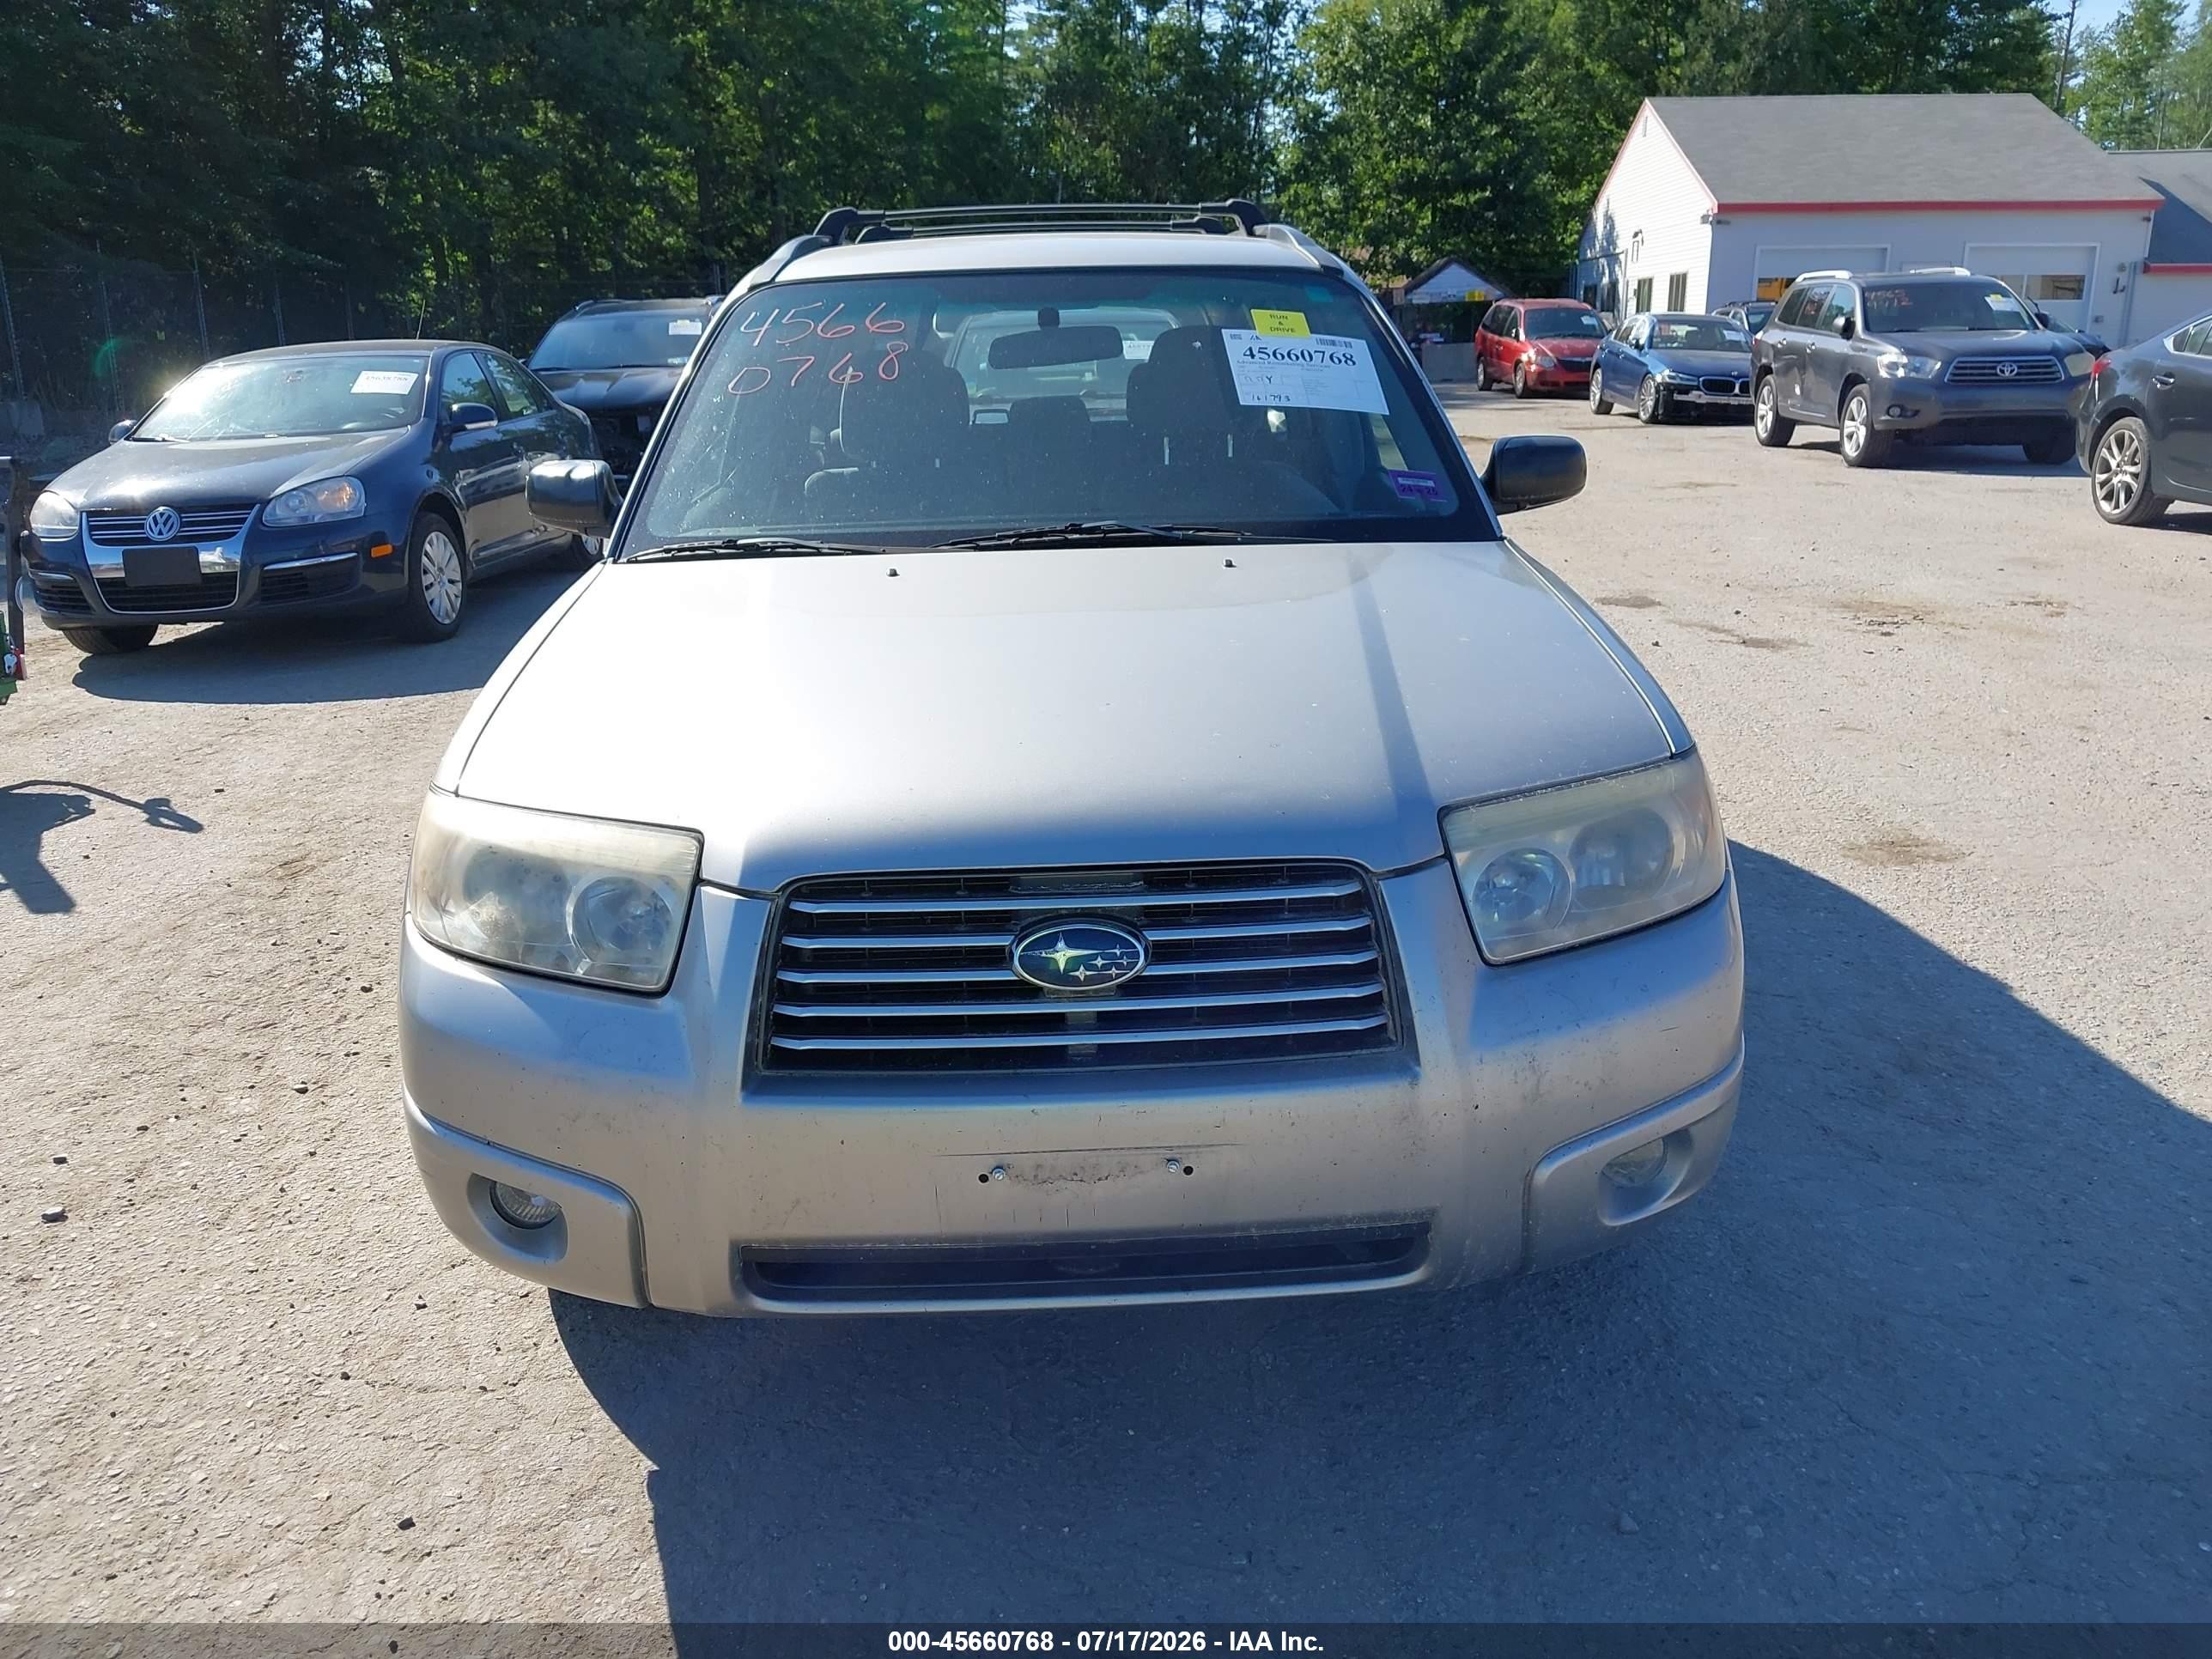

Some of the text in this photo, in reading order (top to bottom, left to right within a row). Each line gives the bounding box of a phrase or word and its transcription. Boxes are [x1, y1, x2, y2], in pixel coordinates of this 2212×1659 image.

[740, 302, 905, 347] 4566
[728, 342, 908, 395] 0768
[1243, 345, 1357, 367] 45660768
